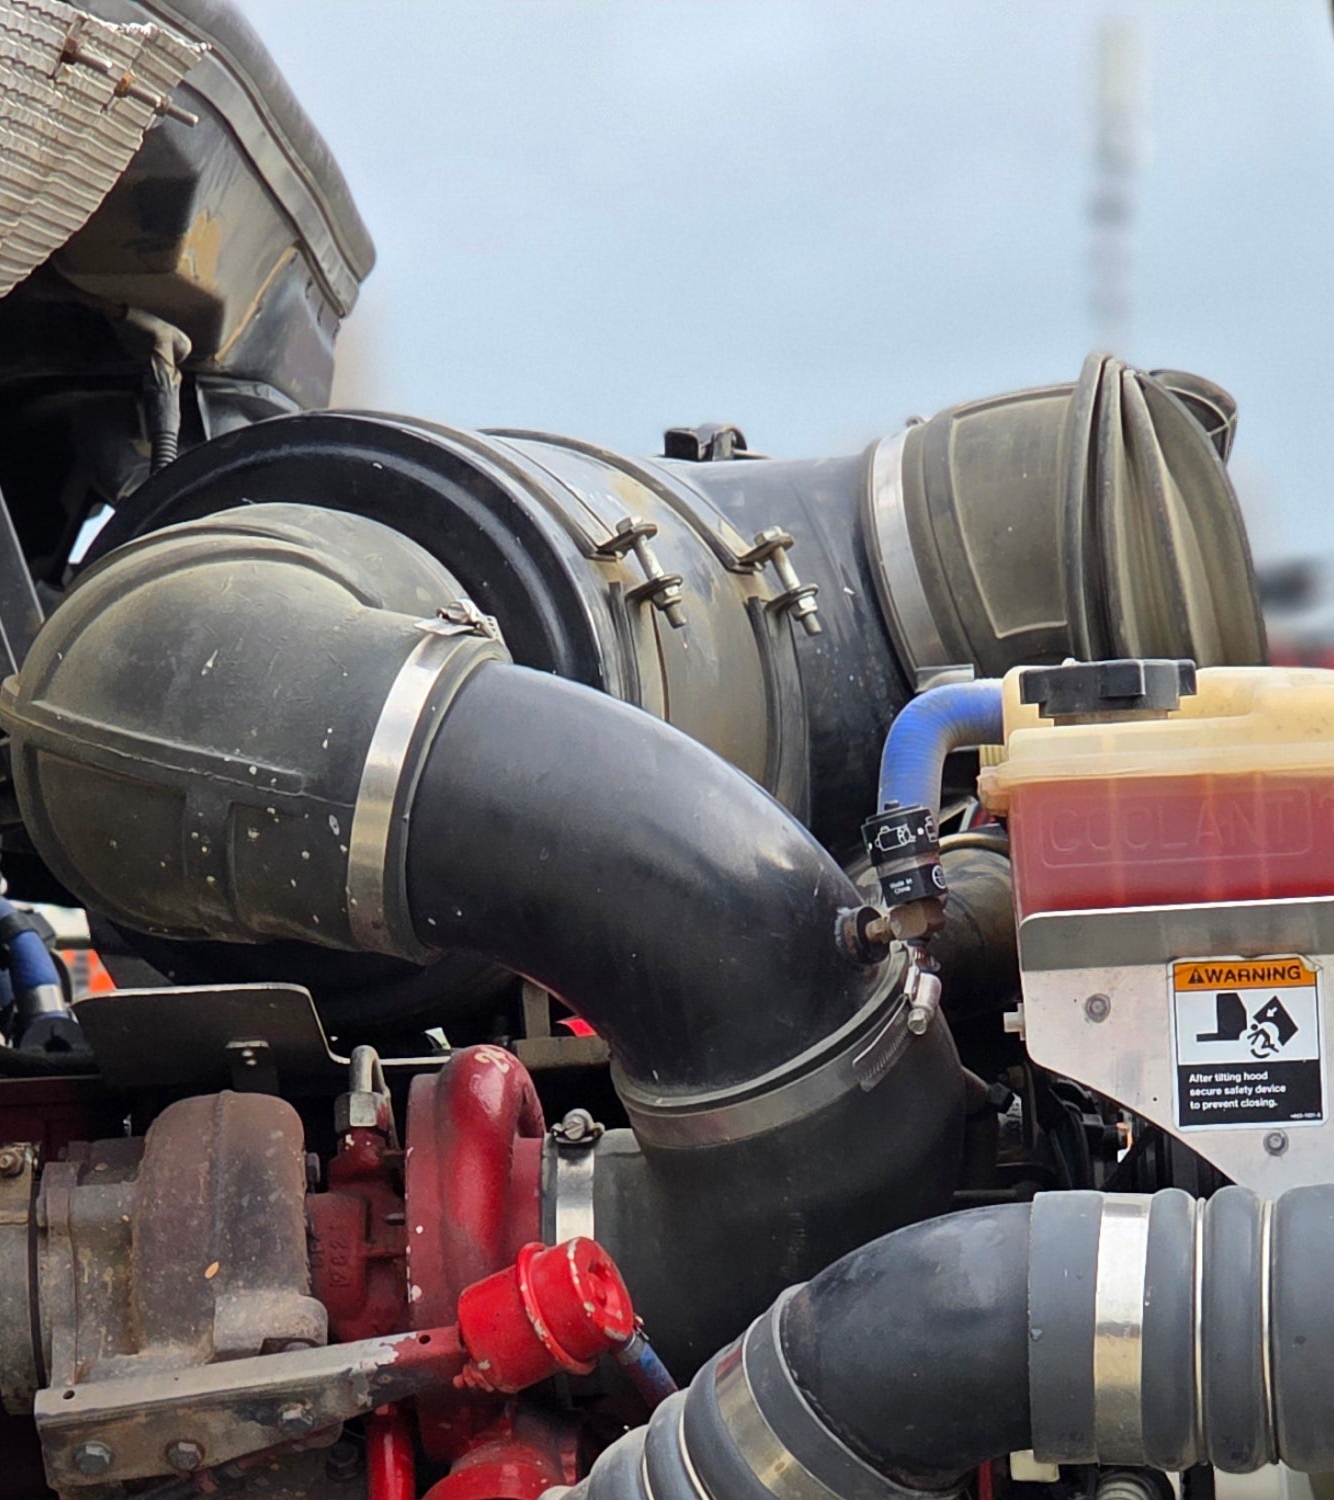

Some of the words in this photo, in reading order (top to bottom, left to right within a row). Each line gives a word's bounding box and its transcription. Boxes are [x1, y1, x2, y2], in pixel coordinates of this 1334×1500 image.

[1051, 798, 1298, 852] COOLANT
[1204, 965, 1301, 983] WARNING
[1189, 1074, 1212, 1083] After
[1214, 1072, 1241, 1083] tilting
[1243, 1071, 1268, 1081] hood
[1190, 1088, 1222, 1096] secure
[1224, 1086, 1253, 1096] safety
[1255, 1084, 1286, 1093] device
[1190, 1101, 1200, 1109] to
[1202, 1100, 1238, 1111] prevent
[1240, 1098, 1278, 1109] closing.
